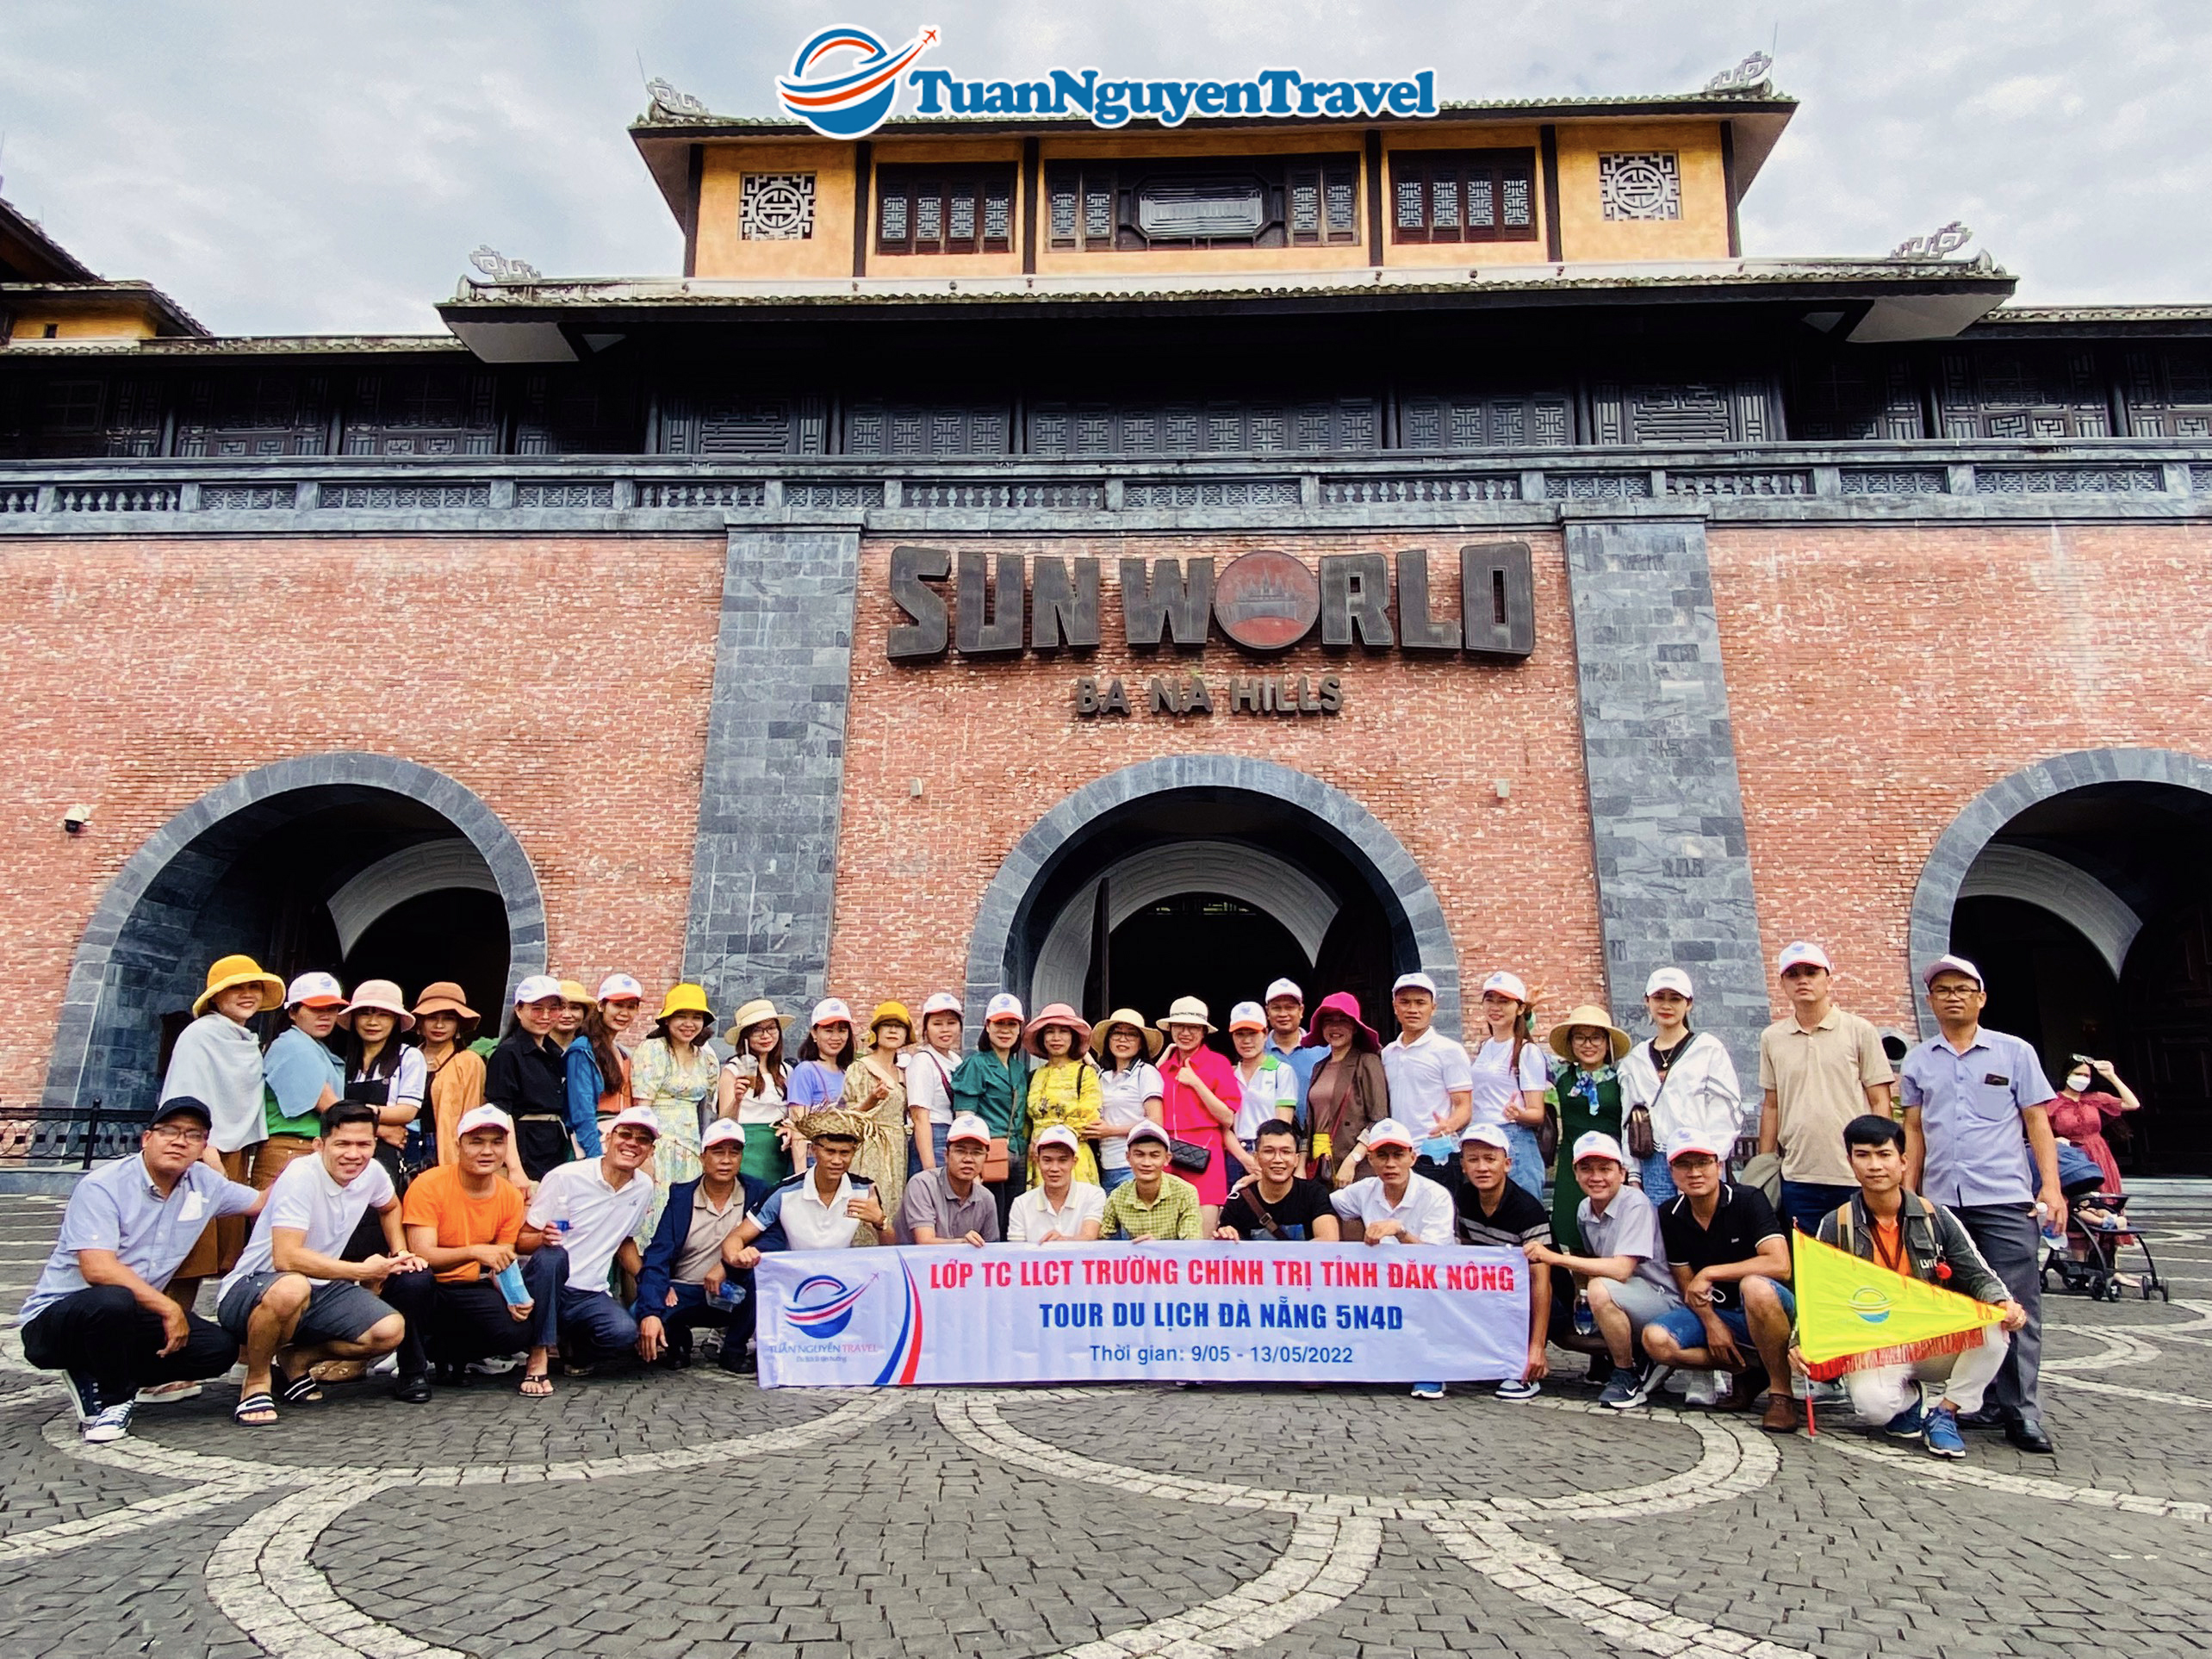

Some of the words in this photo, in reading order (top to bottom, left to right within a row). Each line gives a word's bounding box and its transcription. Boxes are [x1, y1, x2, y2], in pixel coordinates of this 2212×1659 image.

[888, 546, 1100, 660] SUN
[1121, 541, 1536, 657] WORLD
[1077, 676, 1131, 715] BA
[1151, 677, 1213, 714] NA
[1230, 674, 1344, 713] HILLS
[930, 1259, 972, 1289] LỚP
[982, 1262, 1011, 1287] TC
[1021, 1260, 1073, 1286] LLCT
[1082, 1255, 1177, 1285] TRƯỜNG
[1188, 1256, 1264, 1285] CHÍNH
[1273, 1260, 1312, 1291] TRỊ
[1320, 1255, 1378, 1288] TỈNH
[1387, 1258, 1438, 1289] ĐĂK
[1446, 1261, 1515, 1291] NÔNG
[1040, 1303, 1103, 1327] TOUR
[1113, 1302, 1145, 1327] DU
[1154, 1302, 1209, 1331] LỊCH
[1218, 1299, 1252, 1327] ĐÀ
[1260, 1296, 1327, 1328] NẴNG
[1336, 1305, 1403, 1330] 5N4D
[1090, 1345, 1130, 1362] Thời
[1137, 1345, 1185, 1365] gian:
[1191, 1345, 1231, 1362] 9/05
[1252, 1346, 1353, 1364] 13/05/2022
